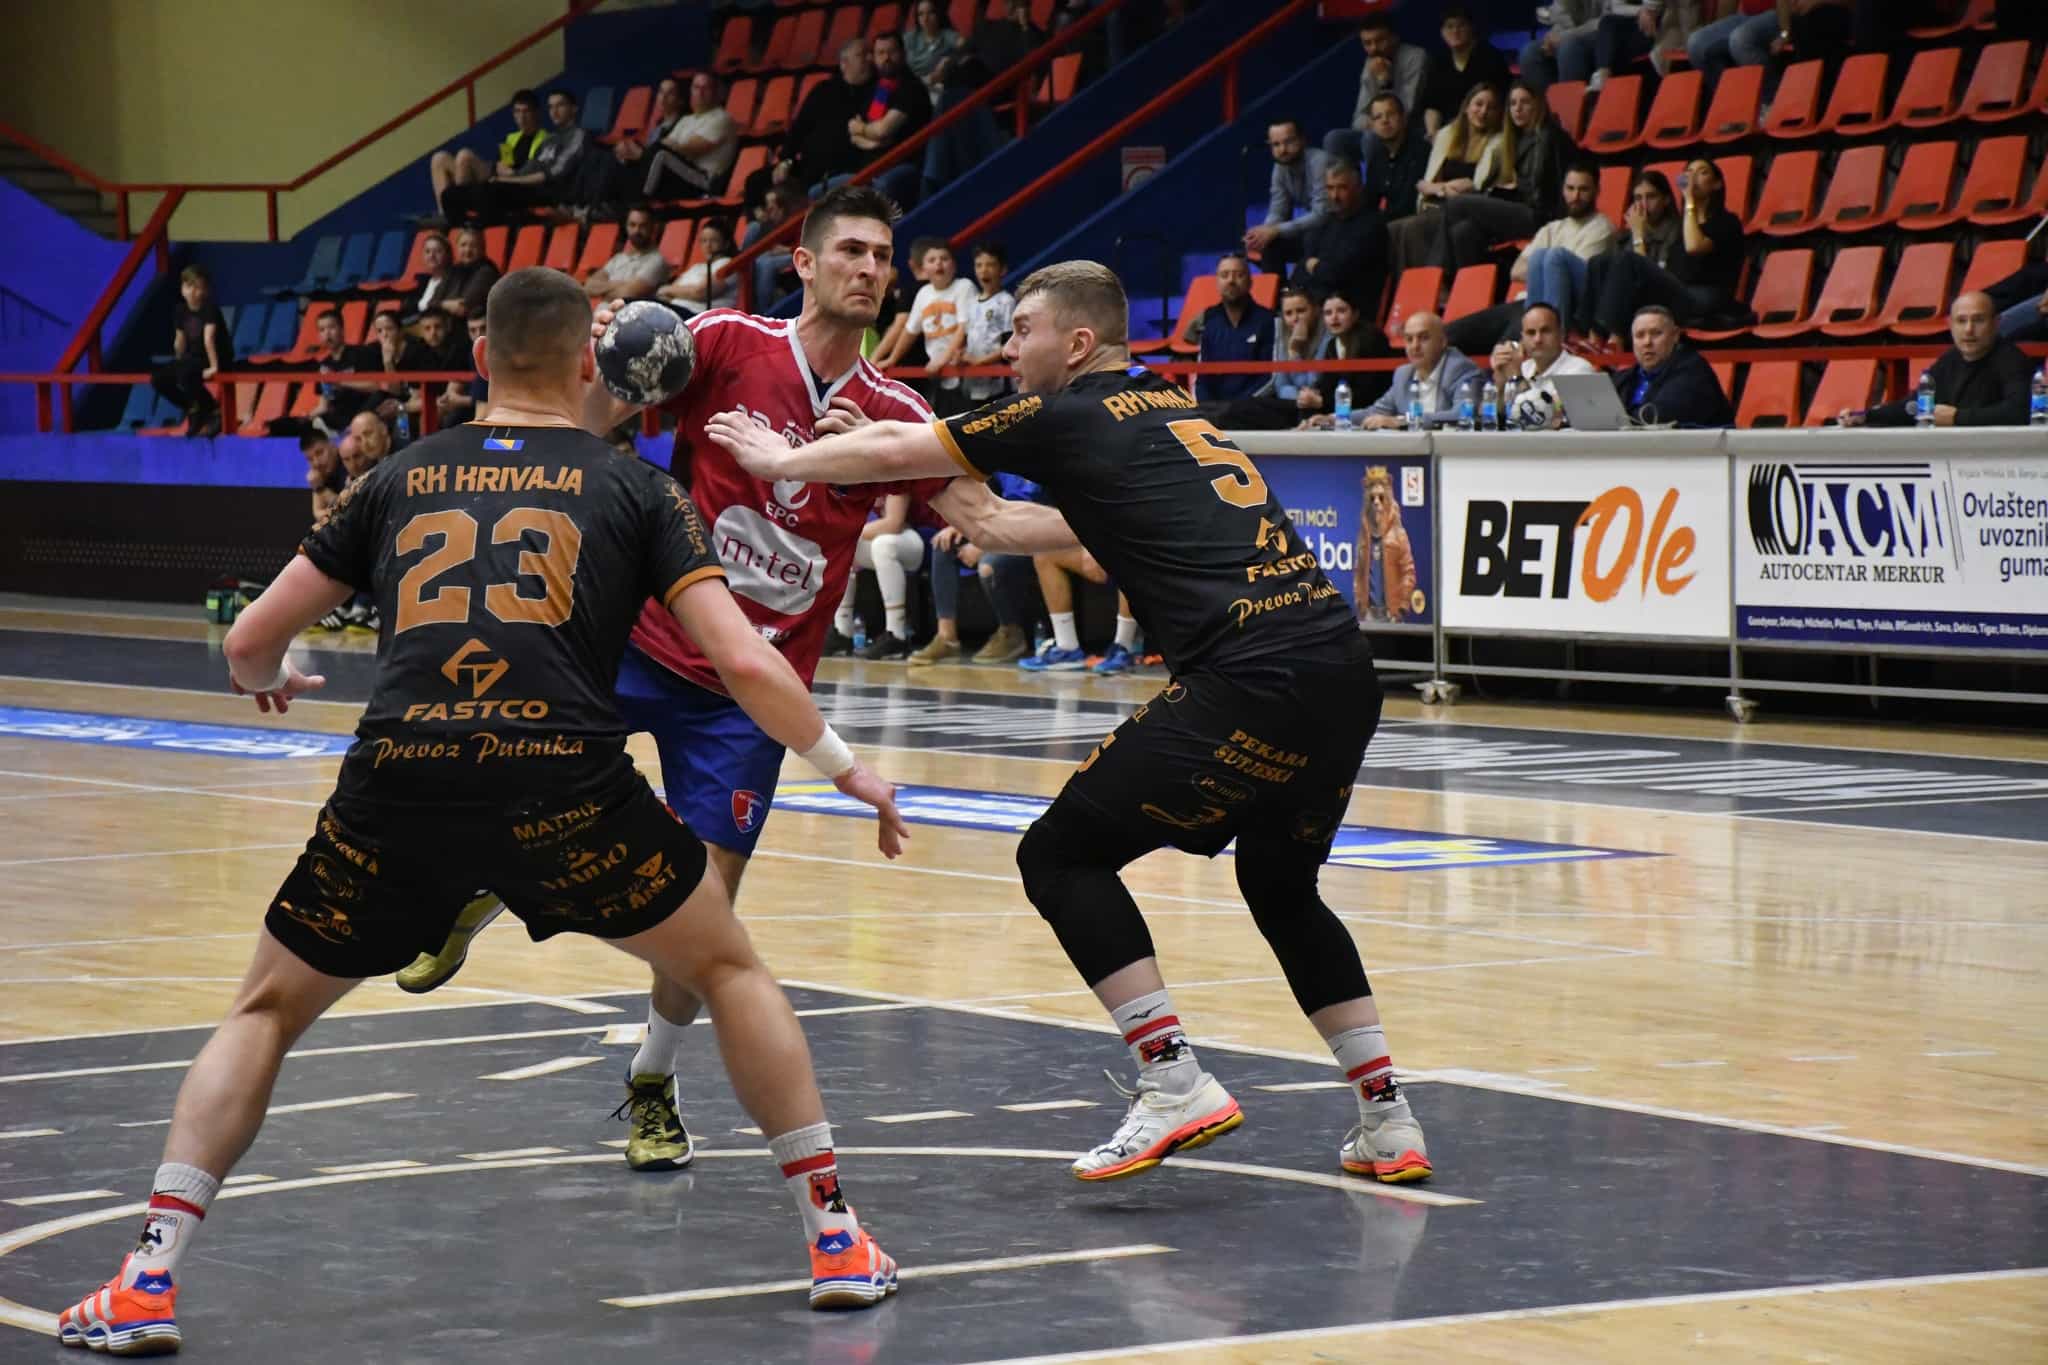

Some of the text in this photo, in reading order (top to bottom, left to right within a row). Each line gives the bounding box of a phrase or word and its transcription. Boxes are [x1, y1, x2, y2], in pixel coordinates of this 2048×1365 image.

[454, 464, 583, 496] KRIVAJA
[1166, 418, 1268, 509] 5
[1979, 522, 2048, 547] uvozni
[396, 507, 583, 634] 23
[722, 535, 814, 591] m:tel
[1760, 562, 1945, 584] AUTOCENTAR MERKUR
[403, 700, 549, 721] FASTCO
[374, 737, 461, 768] Prevoz
[469, 731, 584, 762] Putnika
